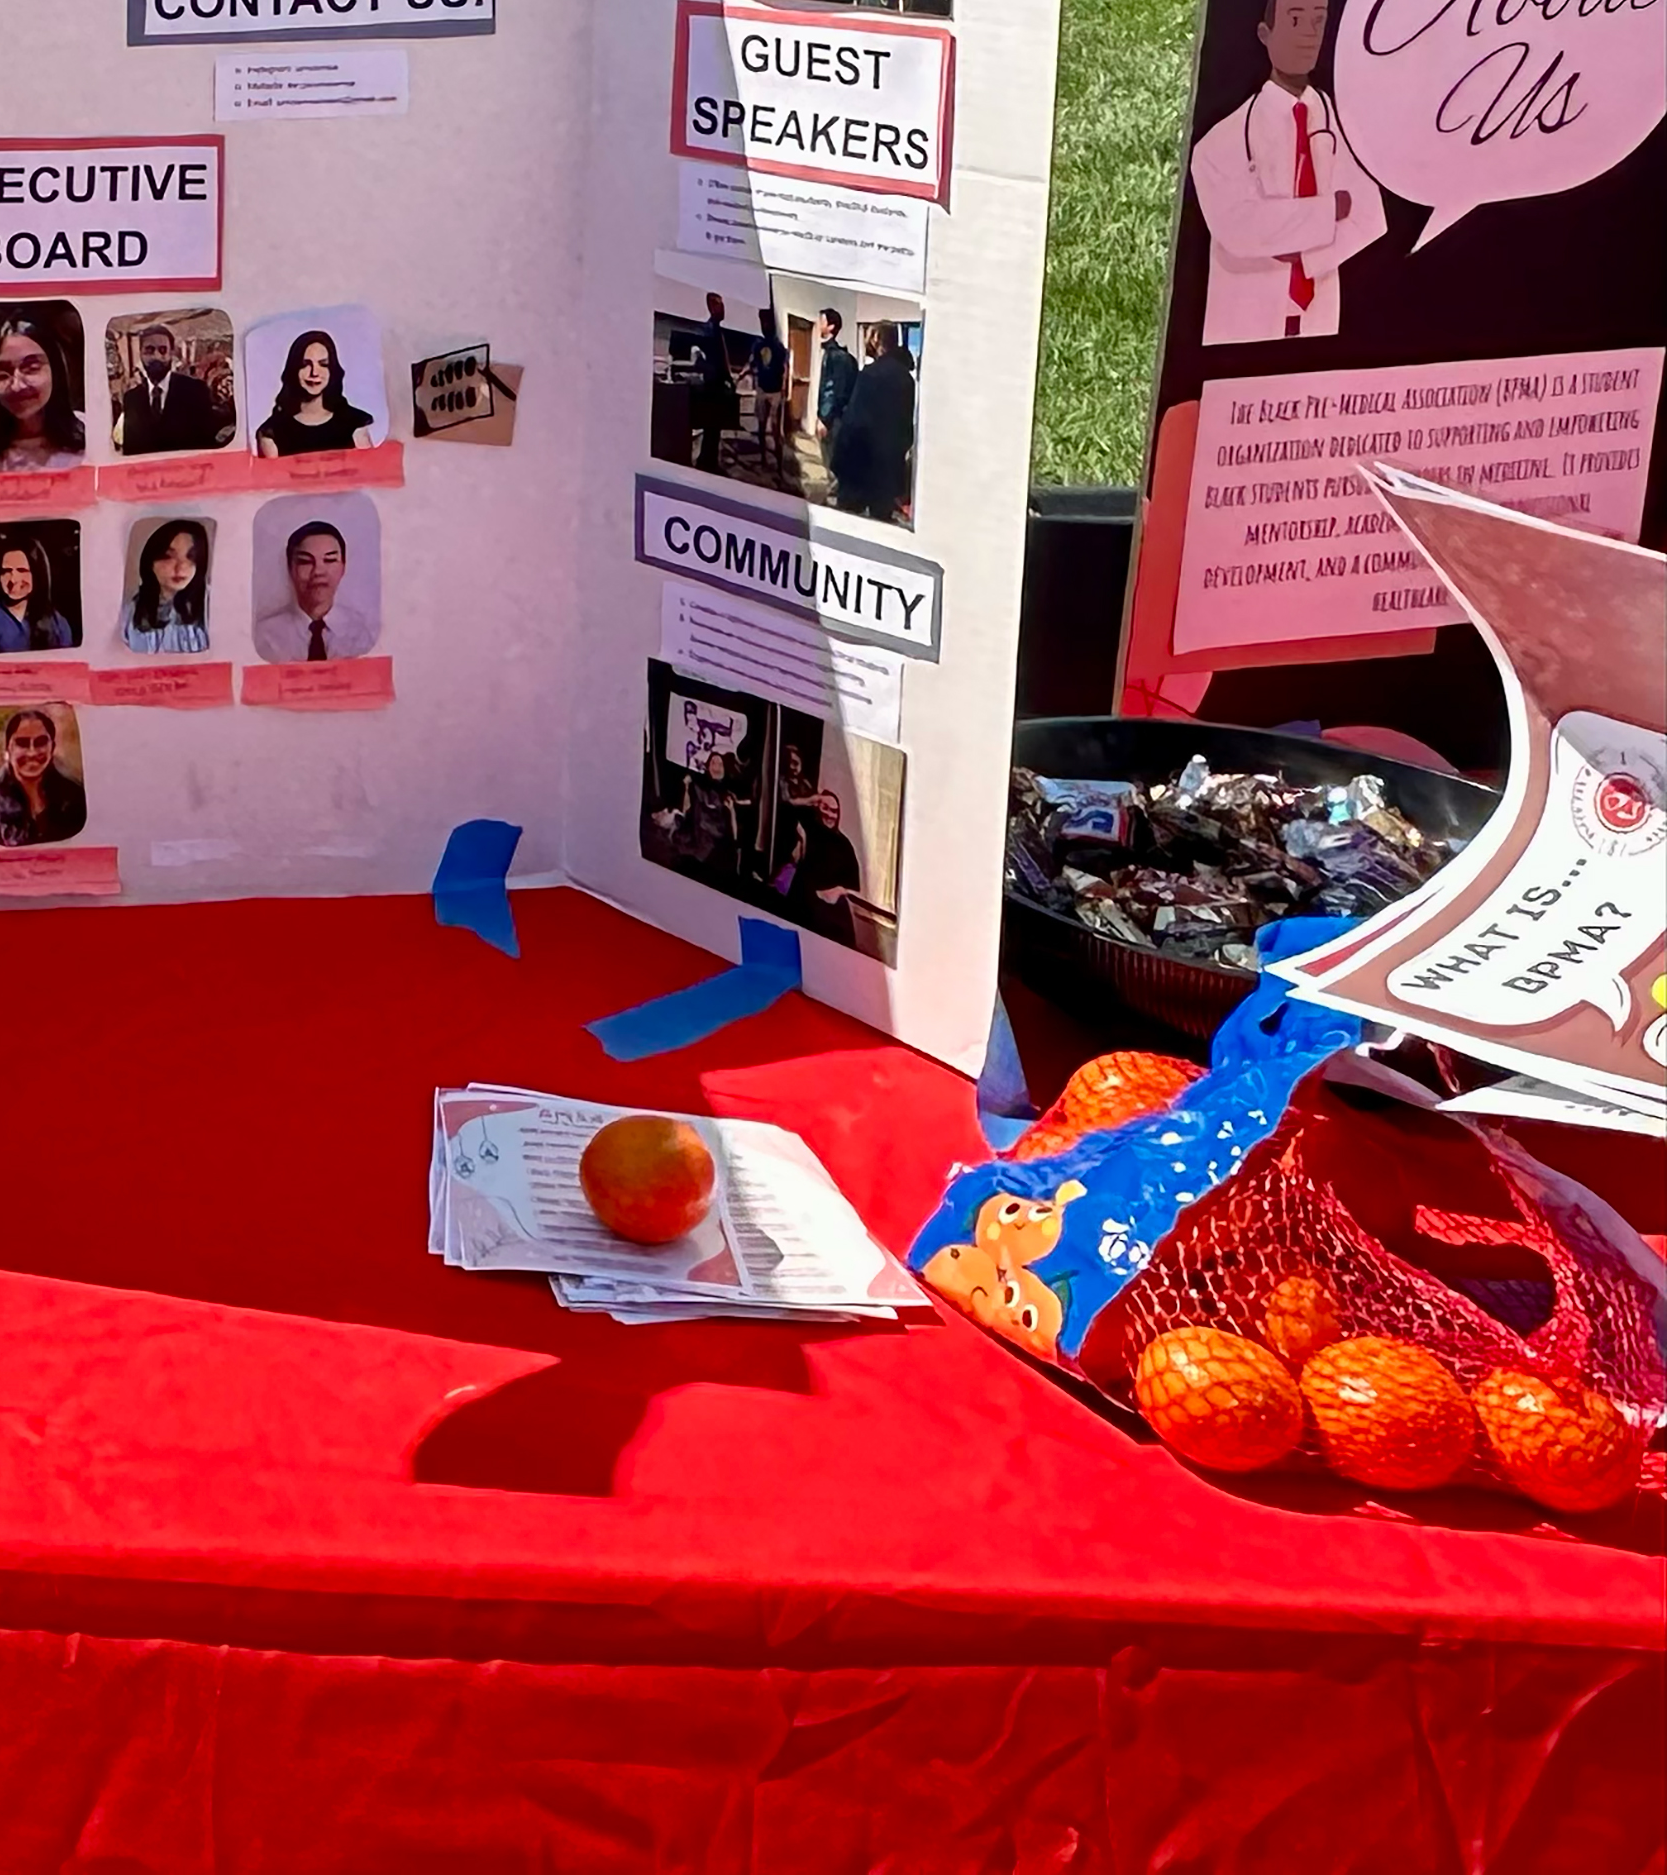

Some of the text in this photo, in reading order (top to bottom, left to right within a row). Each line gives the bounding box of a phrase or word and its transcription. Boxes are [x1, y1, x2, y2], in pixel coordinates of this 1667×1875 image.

[741, 34, 891, 89] GUEST
[1436, 41, 1588, 145] Us
[692, 96, 929, 170] SPEAKERS
[1259, 398, 1302, 423] BLACK
[1305, 389, 1397, 419] PRE-MEDICAL
[1402, 382, 1493, 409] ASSOCIATION
[1496, 373, 1548, 408] (BPMA)
[1551, 375, 1565, 397] IS
[1568, 374, 1578, 395] A
[1581, 368, 1641, 394] STUDENT
[1217, 409, 1641, 466] ORGANIZATION DEDICATED TO SUPPORTING AND EMPOWERING
[1205, 484, 1247, 509] BLACK
[1250, 478, 1320, 505] STUDENTS
[1579, 447, 1641, 475] PROVIDES
[664, 516, 927, 633] COMMUNITY
[1315, 556, 1347, 578] AND
[1350, 555, 1361, 575] A
[1400, 857, 1588, 991] WHAT IS...
[1501, 900, 1633, 995] BPMA?
